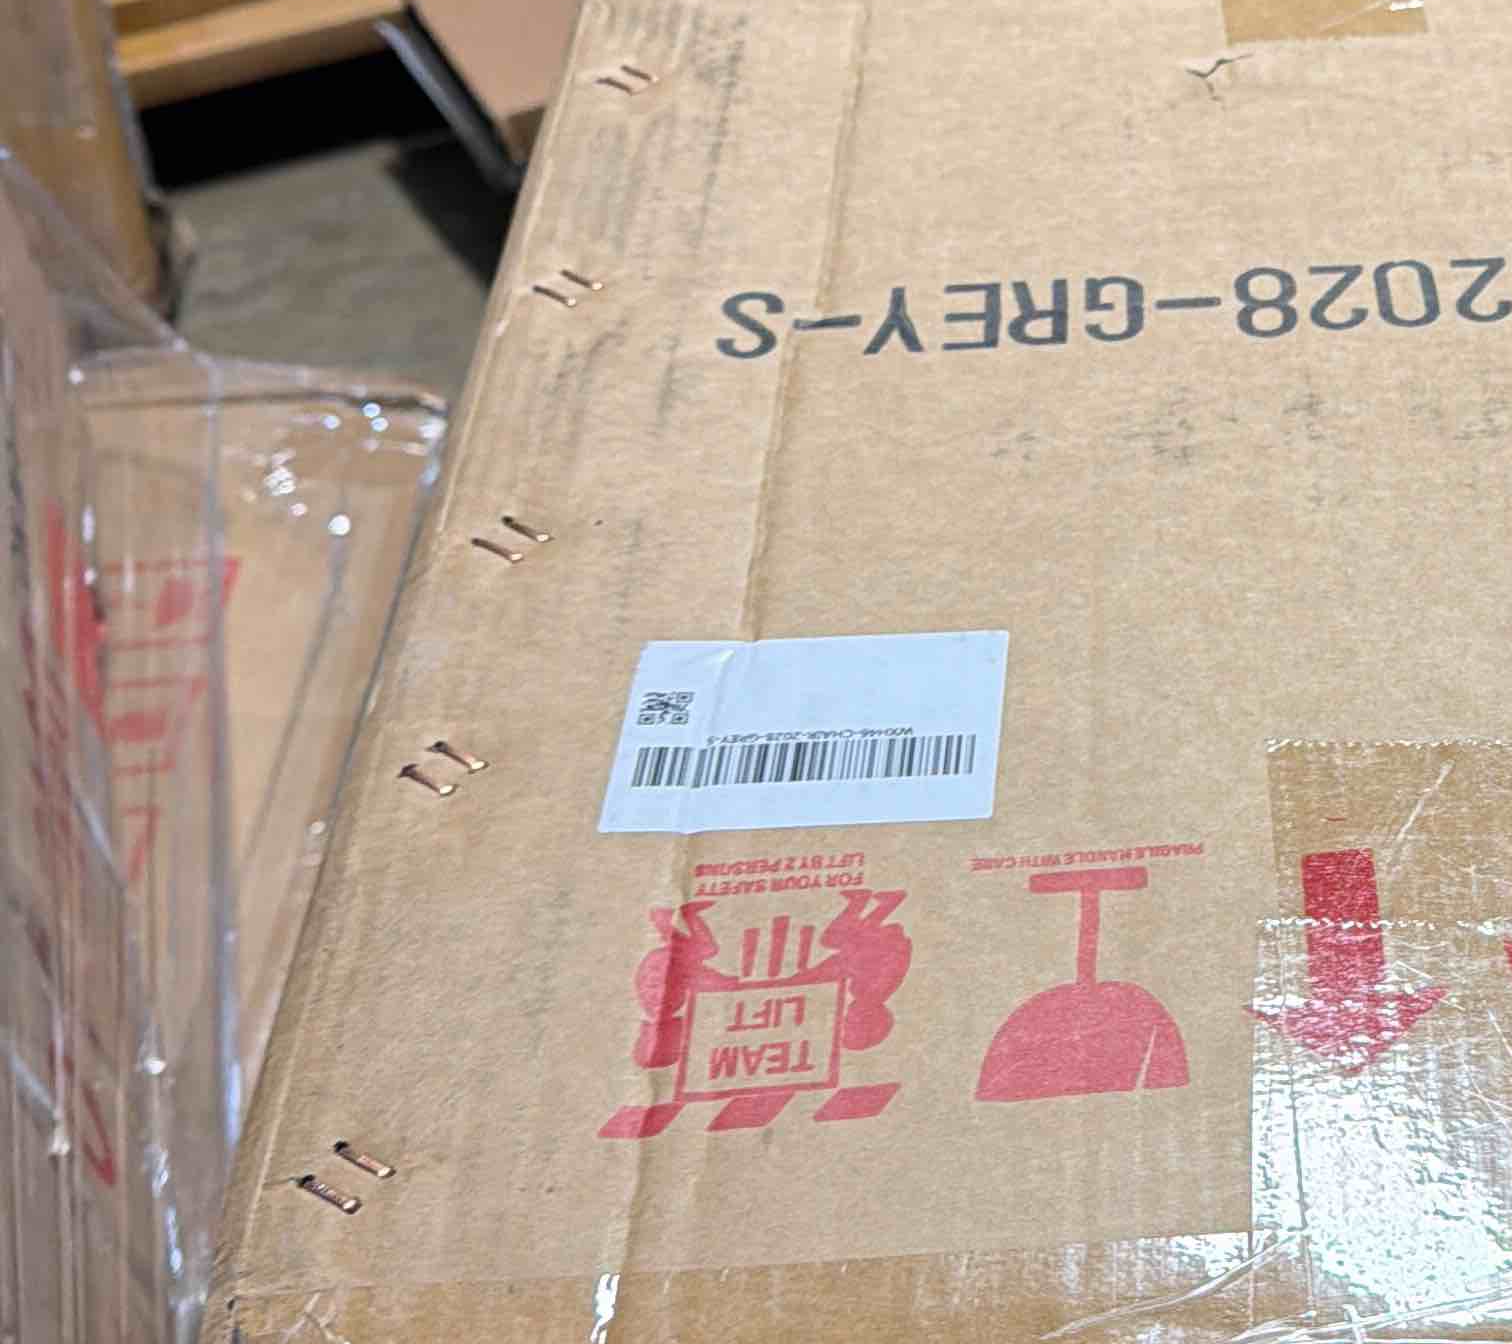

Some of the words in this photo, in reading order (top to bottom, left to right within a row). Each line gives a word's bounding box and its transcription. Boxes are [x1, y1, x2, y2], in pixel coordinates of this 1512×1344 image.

[770, 875, 822, 893] YOUR
[826, 872, 864, 888] FOR
[726, 994, 806, 1032] LIFT
[709, 1040, 815, 1080] TEAM
